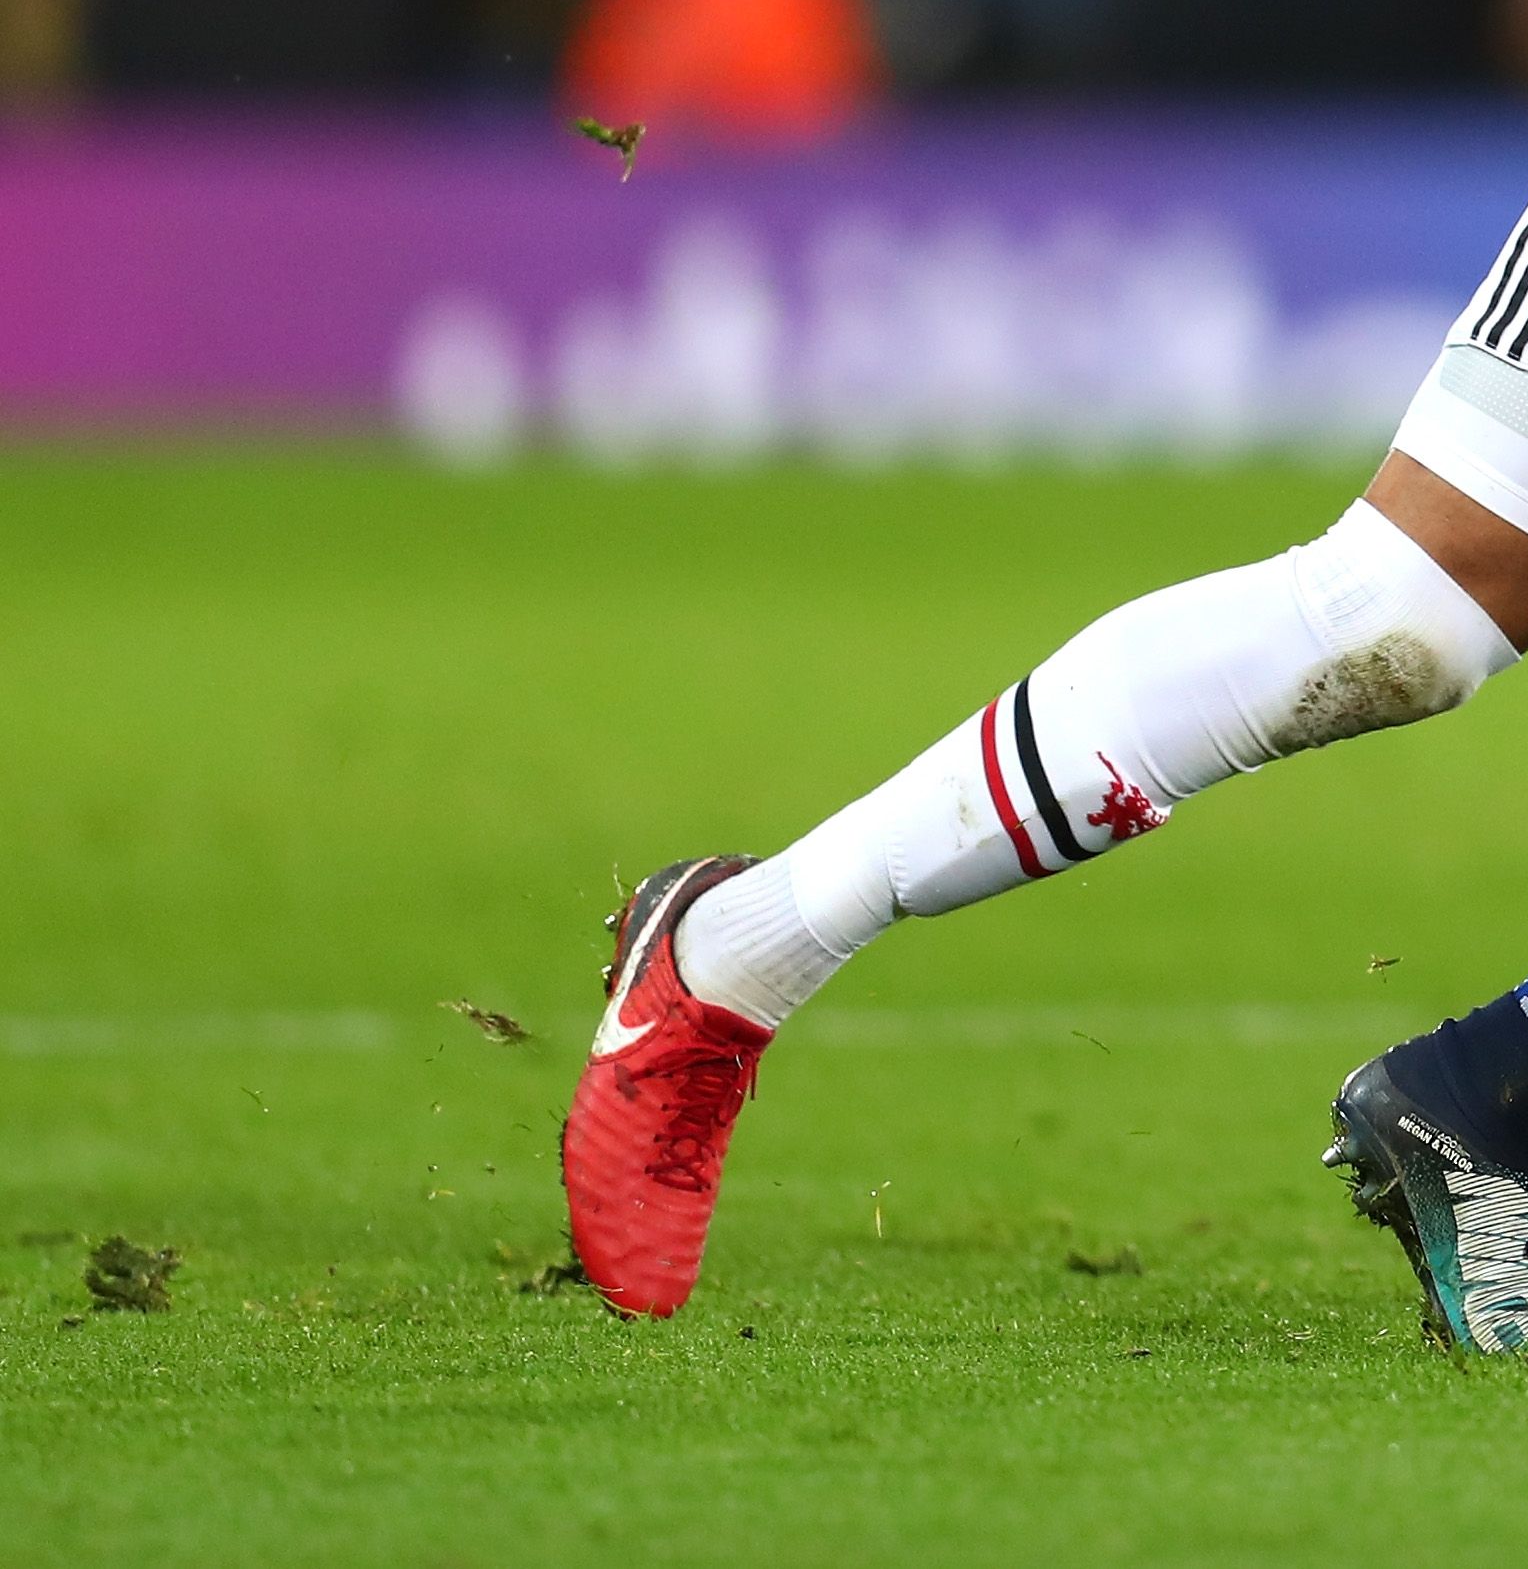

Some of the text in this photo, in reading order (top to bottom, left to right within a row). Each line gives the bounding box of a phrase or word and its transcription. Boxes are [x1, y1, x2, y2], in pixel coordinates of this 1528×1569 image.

[1397, 1115, 1474, 1173] MEGAN & TAYLOR
